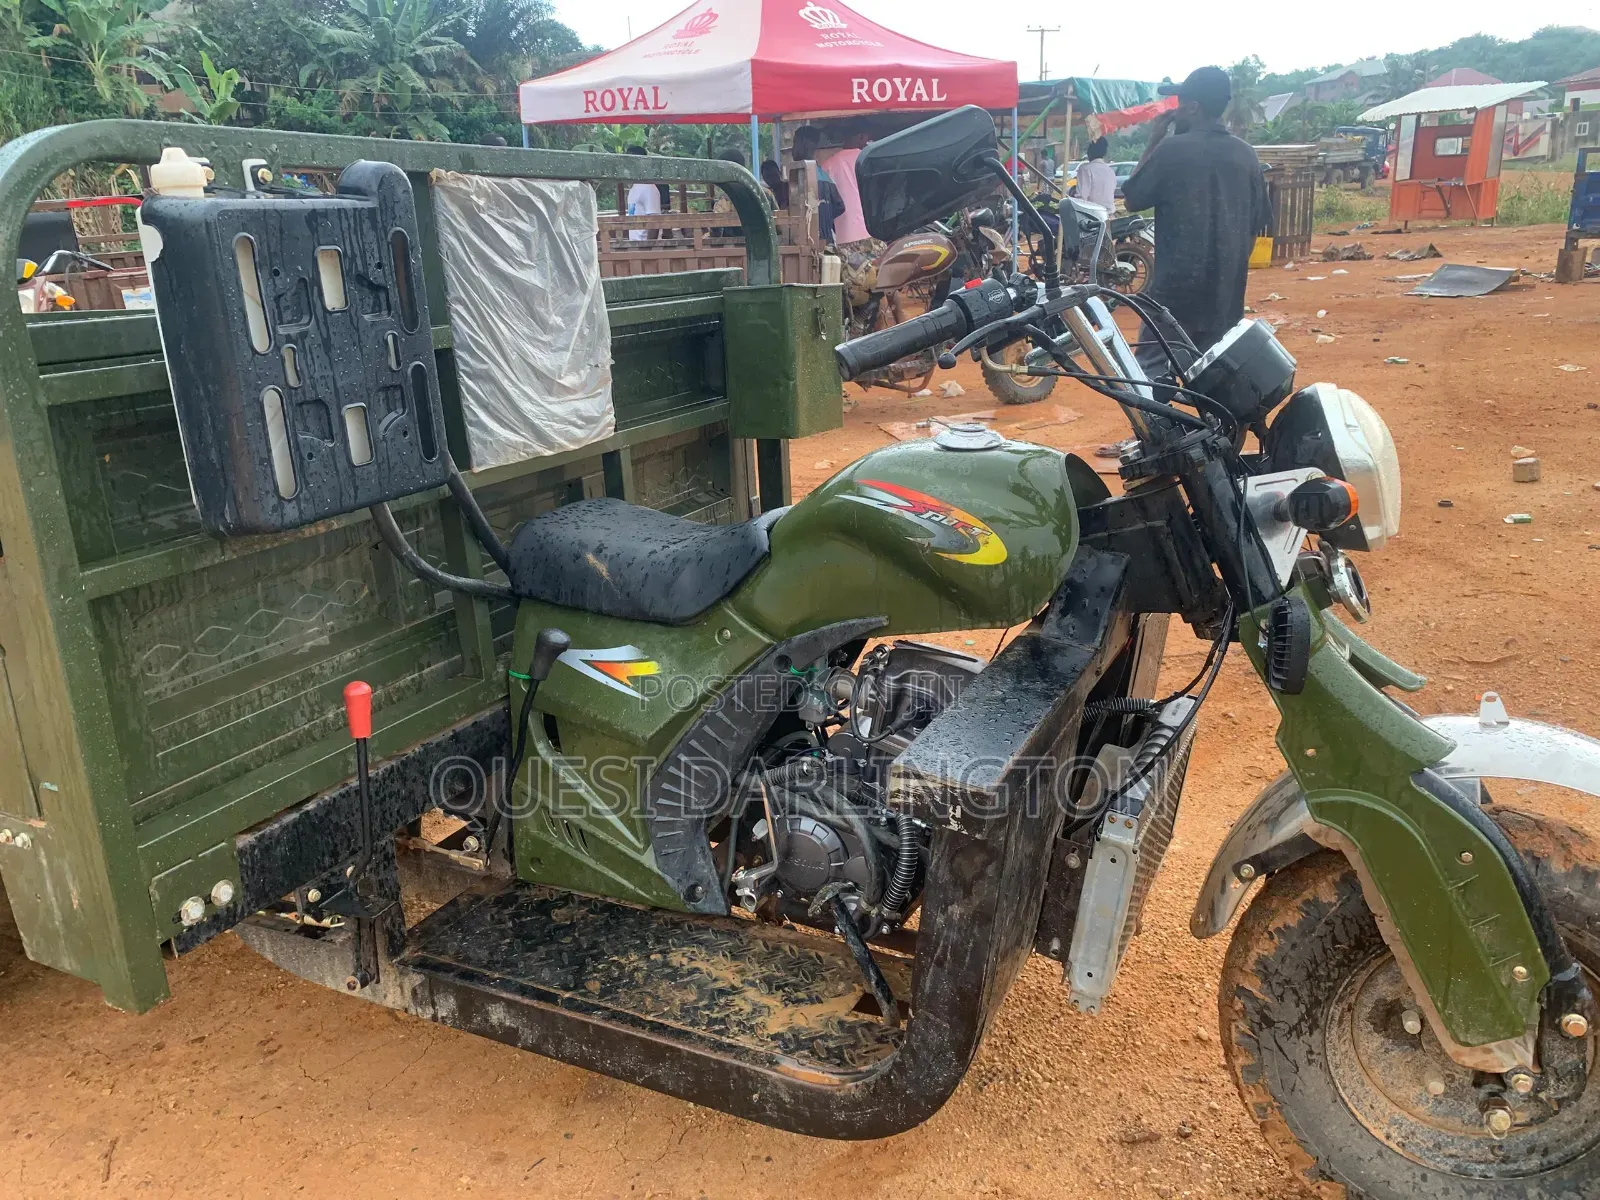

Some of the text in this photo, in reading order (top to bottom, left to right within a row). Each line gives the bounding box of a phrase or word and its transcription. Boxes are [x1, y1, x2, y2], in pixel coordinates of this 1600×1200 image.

[820, 32, 861, 41] ROYAL
[815, 40, 884, 48] MOTORCYCLE
[851, 78, 947, 103] ROYAL
[583, 86, 668, 113] ROYAL
[903, 239, 933, 248] APSONIC
